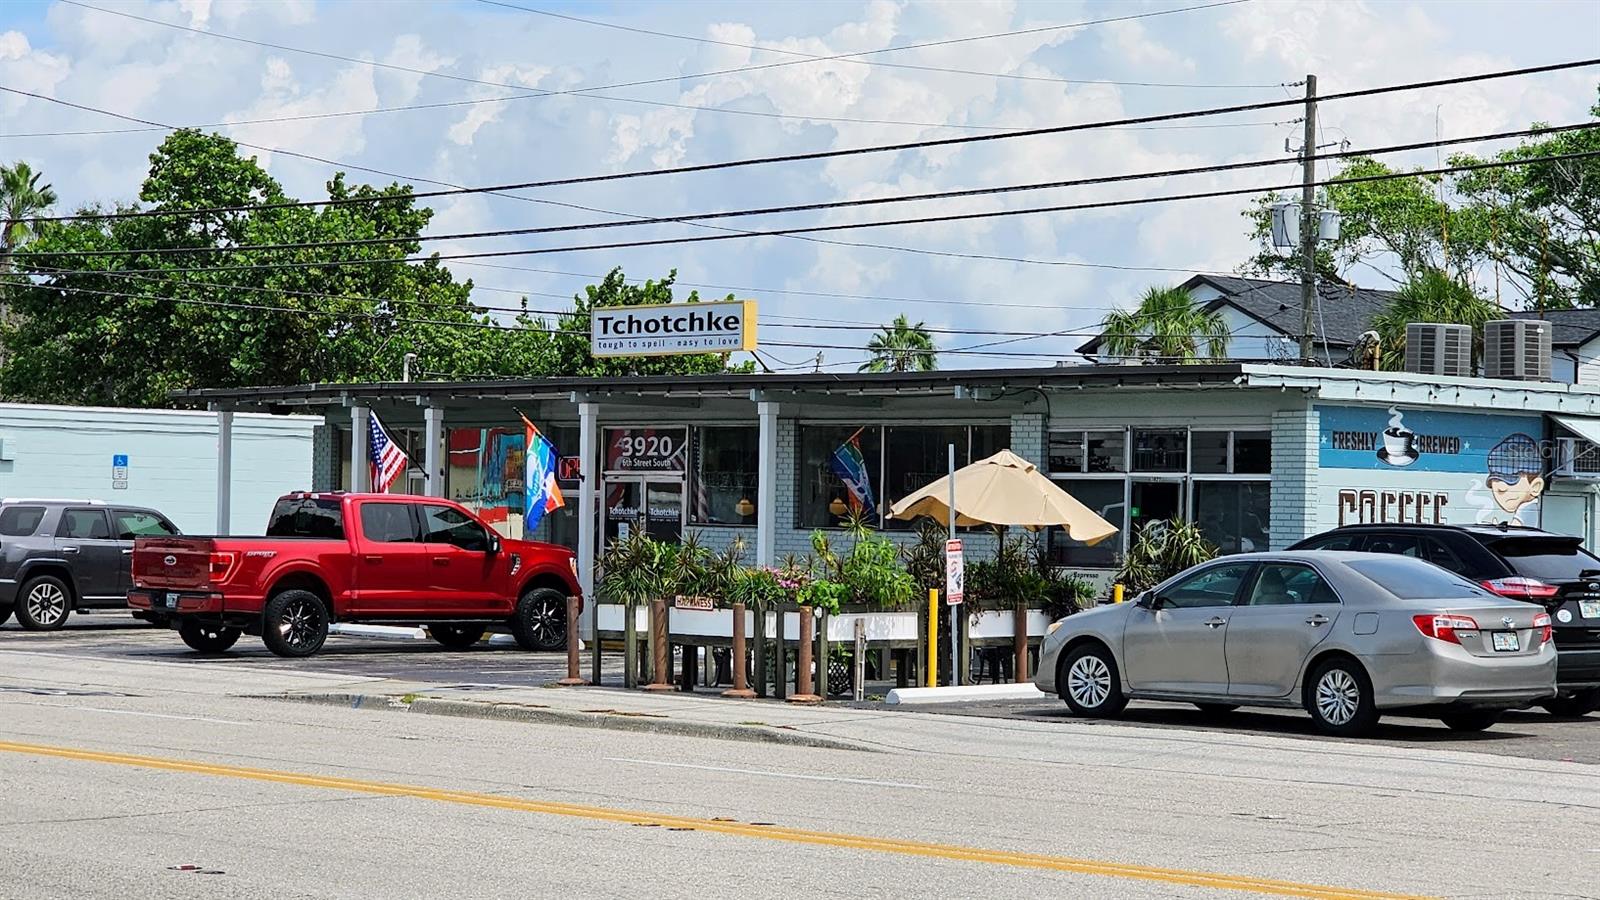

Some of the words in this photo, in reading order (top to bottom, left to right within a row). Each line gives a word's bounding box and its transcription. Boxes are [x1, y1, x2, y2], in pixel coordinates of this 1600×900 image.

[598, 311, 740, 335] Tchotchke
[598, 339, 624, 350] tough
[628, 339, 637, 348] to
[641, 339, 665, 349] spell
[677, 339, 698, 348] easy
[704, 338, 713, 346] to
[718, 337, 739, 345] love
[621, 436, 673, 457] 3920
[1332, 431, 1377, 451] FRESHLY
[1418, 434, 1461, 454] BREWED
[622, 458, 632, 467] 6th
[633, 458, 652, 467] Street
[653, 458, 671, 467] South
[609, 507, 638, 516] Tchotchke
[649, 507, 679, 517] Tchotchke
